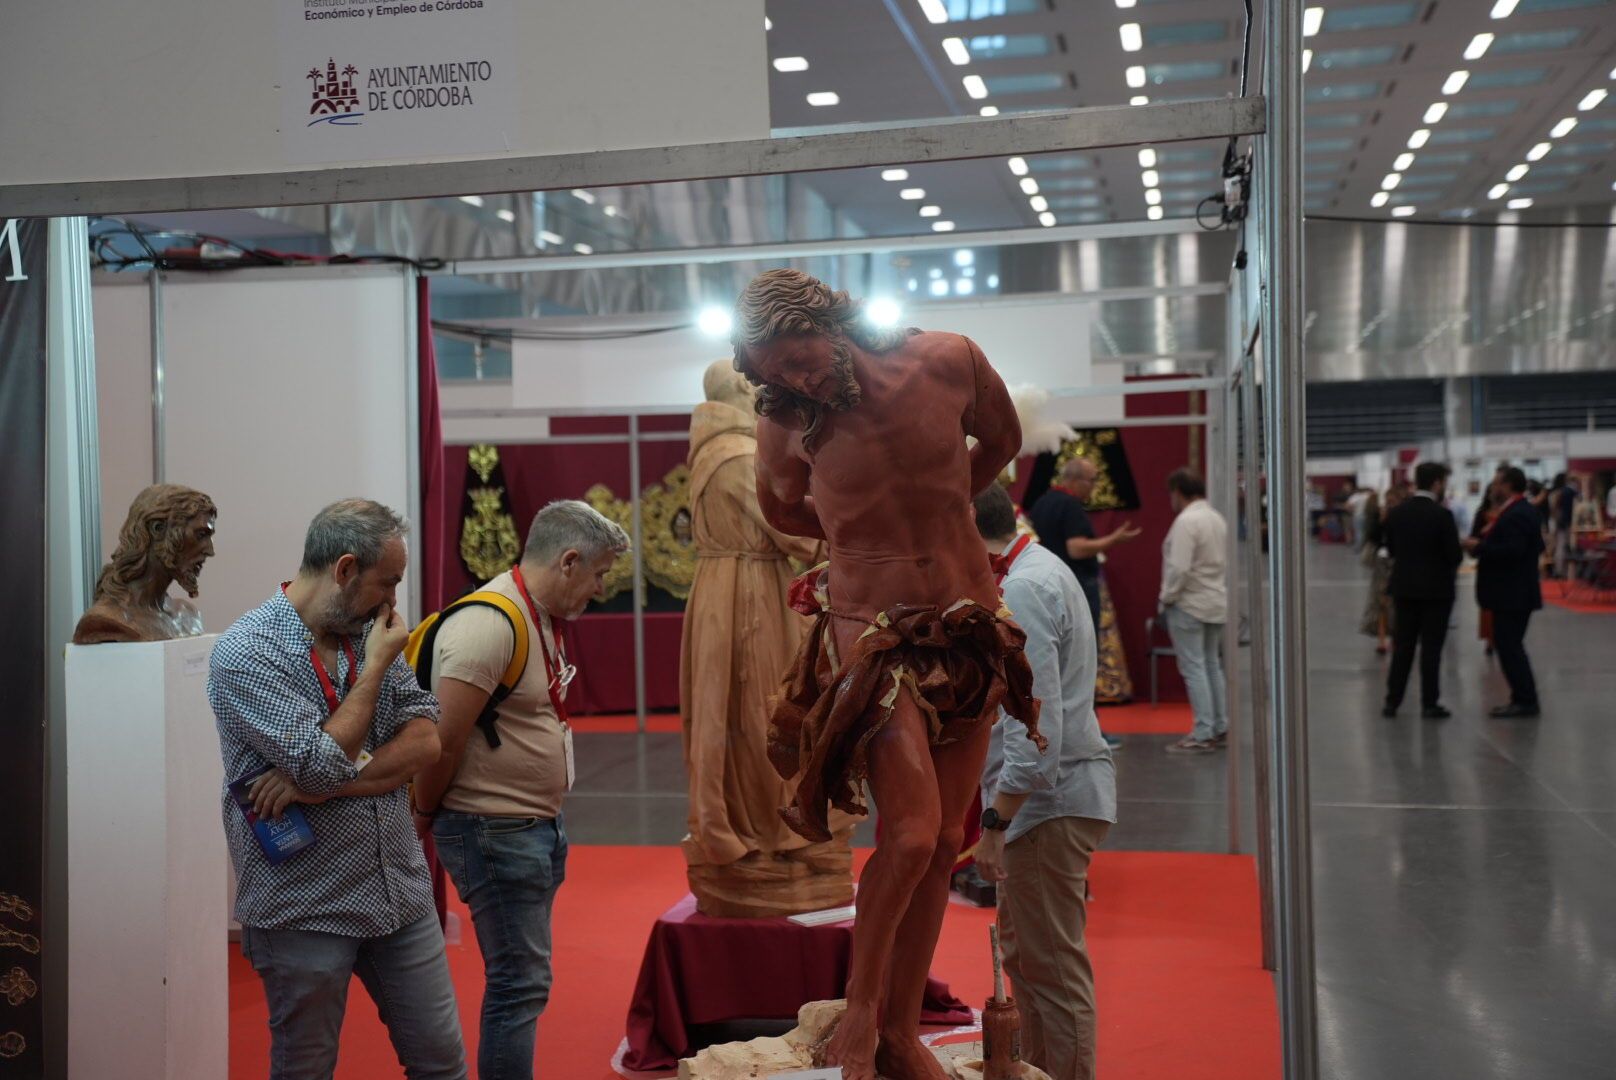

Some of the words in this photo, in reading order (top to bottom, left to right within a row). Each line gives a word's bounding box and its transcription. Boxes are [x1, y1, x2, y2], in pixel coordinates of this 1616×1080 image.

[305, 9, 365, 21] Económico
[367, 9, 375, 18] y
[376, 5, 417, 16] Empleo
[419, 2, 434, 13] de
[367, 60, 492, 89] AYUNTAMIENTO
[368, 91, 389, 112] DE
[393, 86, 473, 109] CÓRDOBA
[269, 818, 292, 836] HOLY
